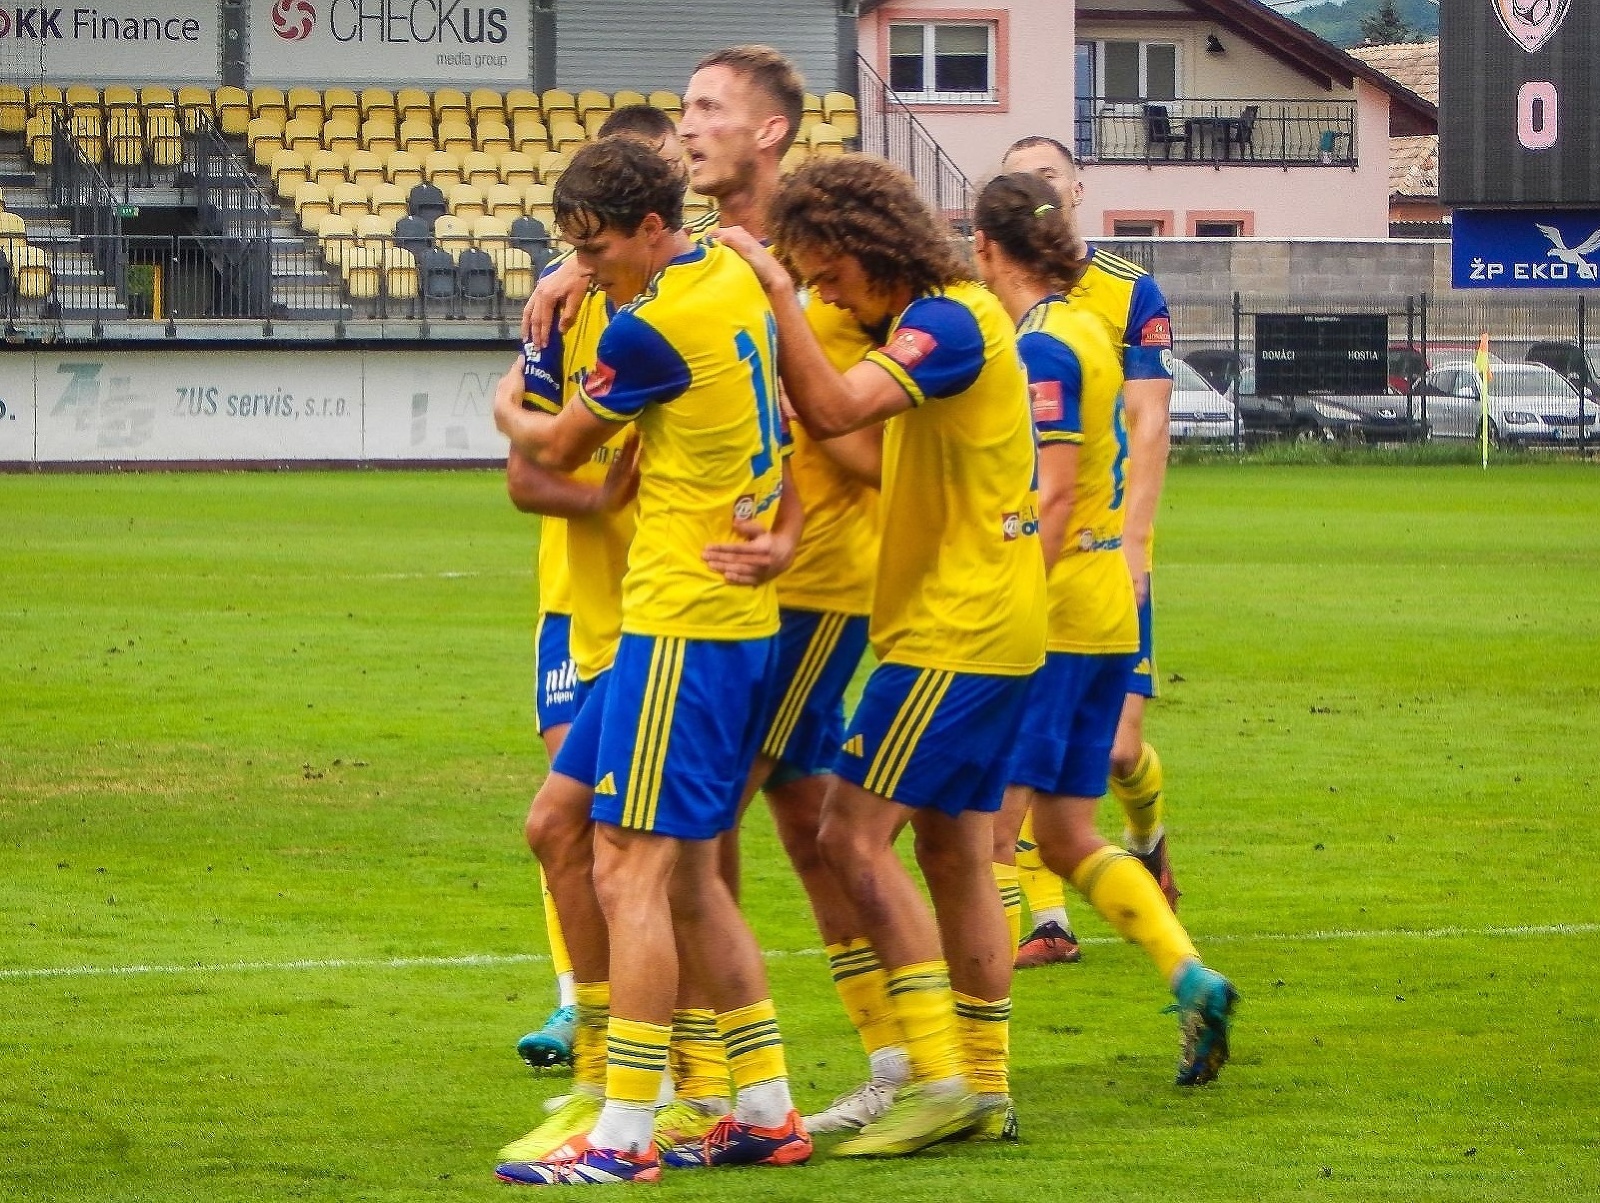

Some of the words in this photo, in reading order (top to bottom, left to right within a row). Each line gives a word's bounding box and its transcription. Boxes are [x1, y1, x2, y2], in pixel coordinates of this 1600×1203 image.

[74, 9, 200, 40] Finance
[330, 0, 508, 43] CHECKus
[437, 52, 472, 66] media
[474, 54, 508, 68] group
[1517, 81, 1558, 149] 0
[1469, 257, 1504, 280] ŽP
[1514, 263, 1568, 279] EKO
[173, 387, 218, 416] ZUS
[227, 387, 300, 420] servis,
[305, 398, 351, 417] s.r.o.
